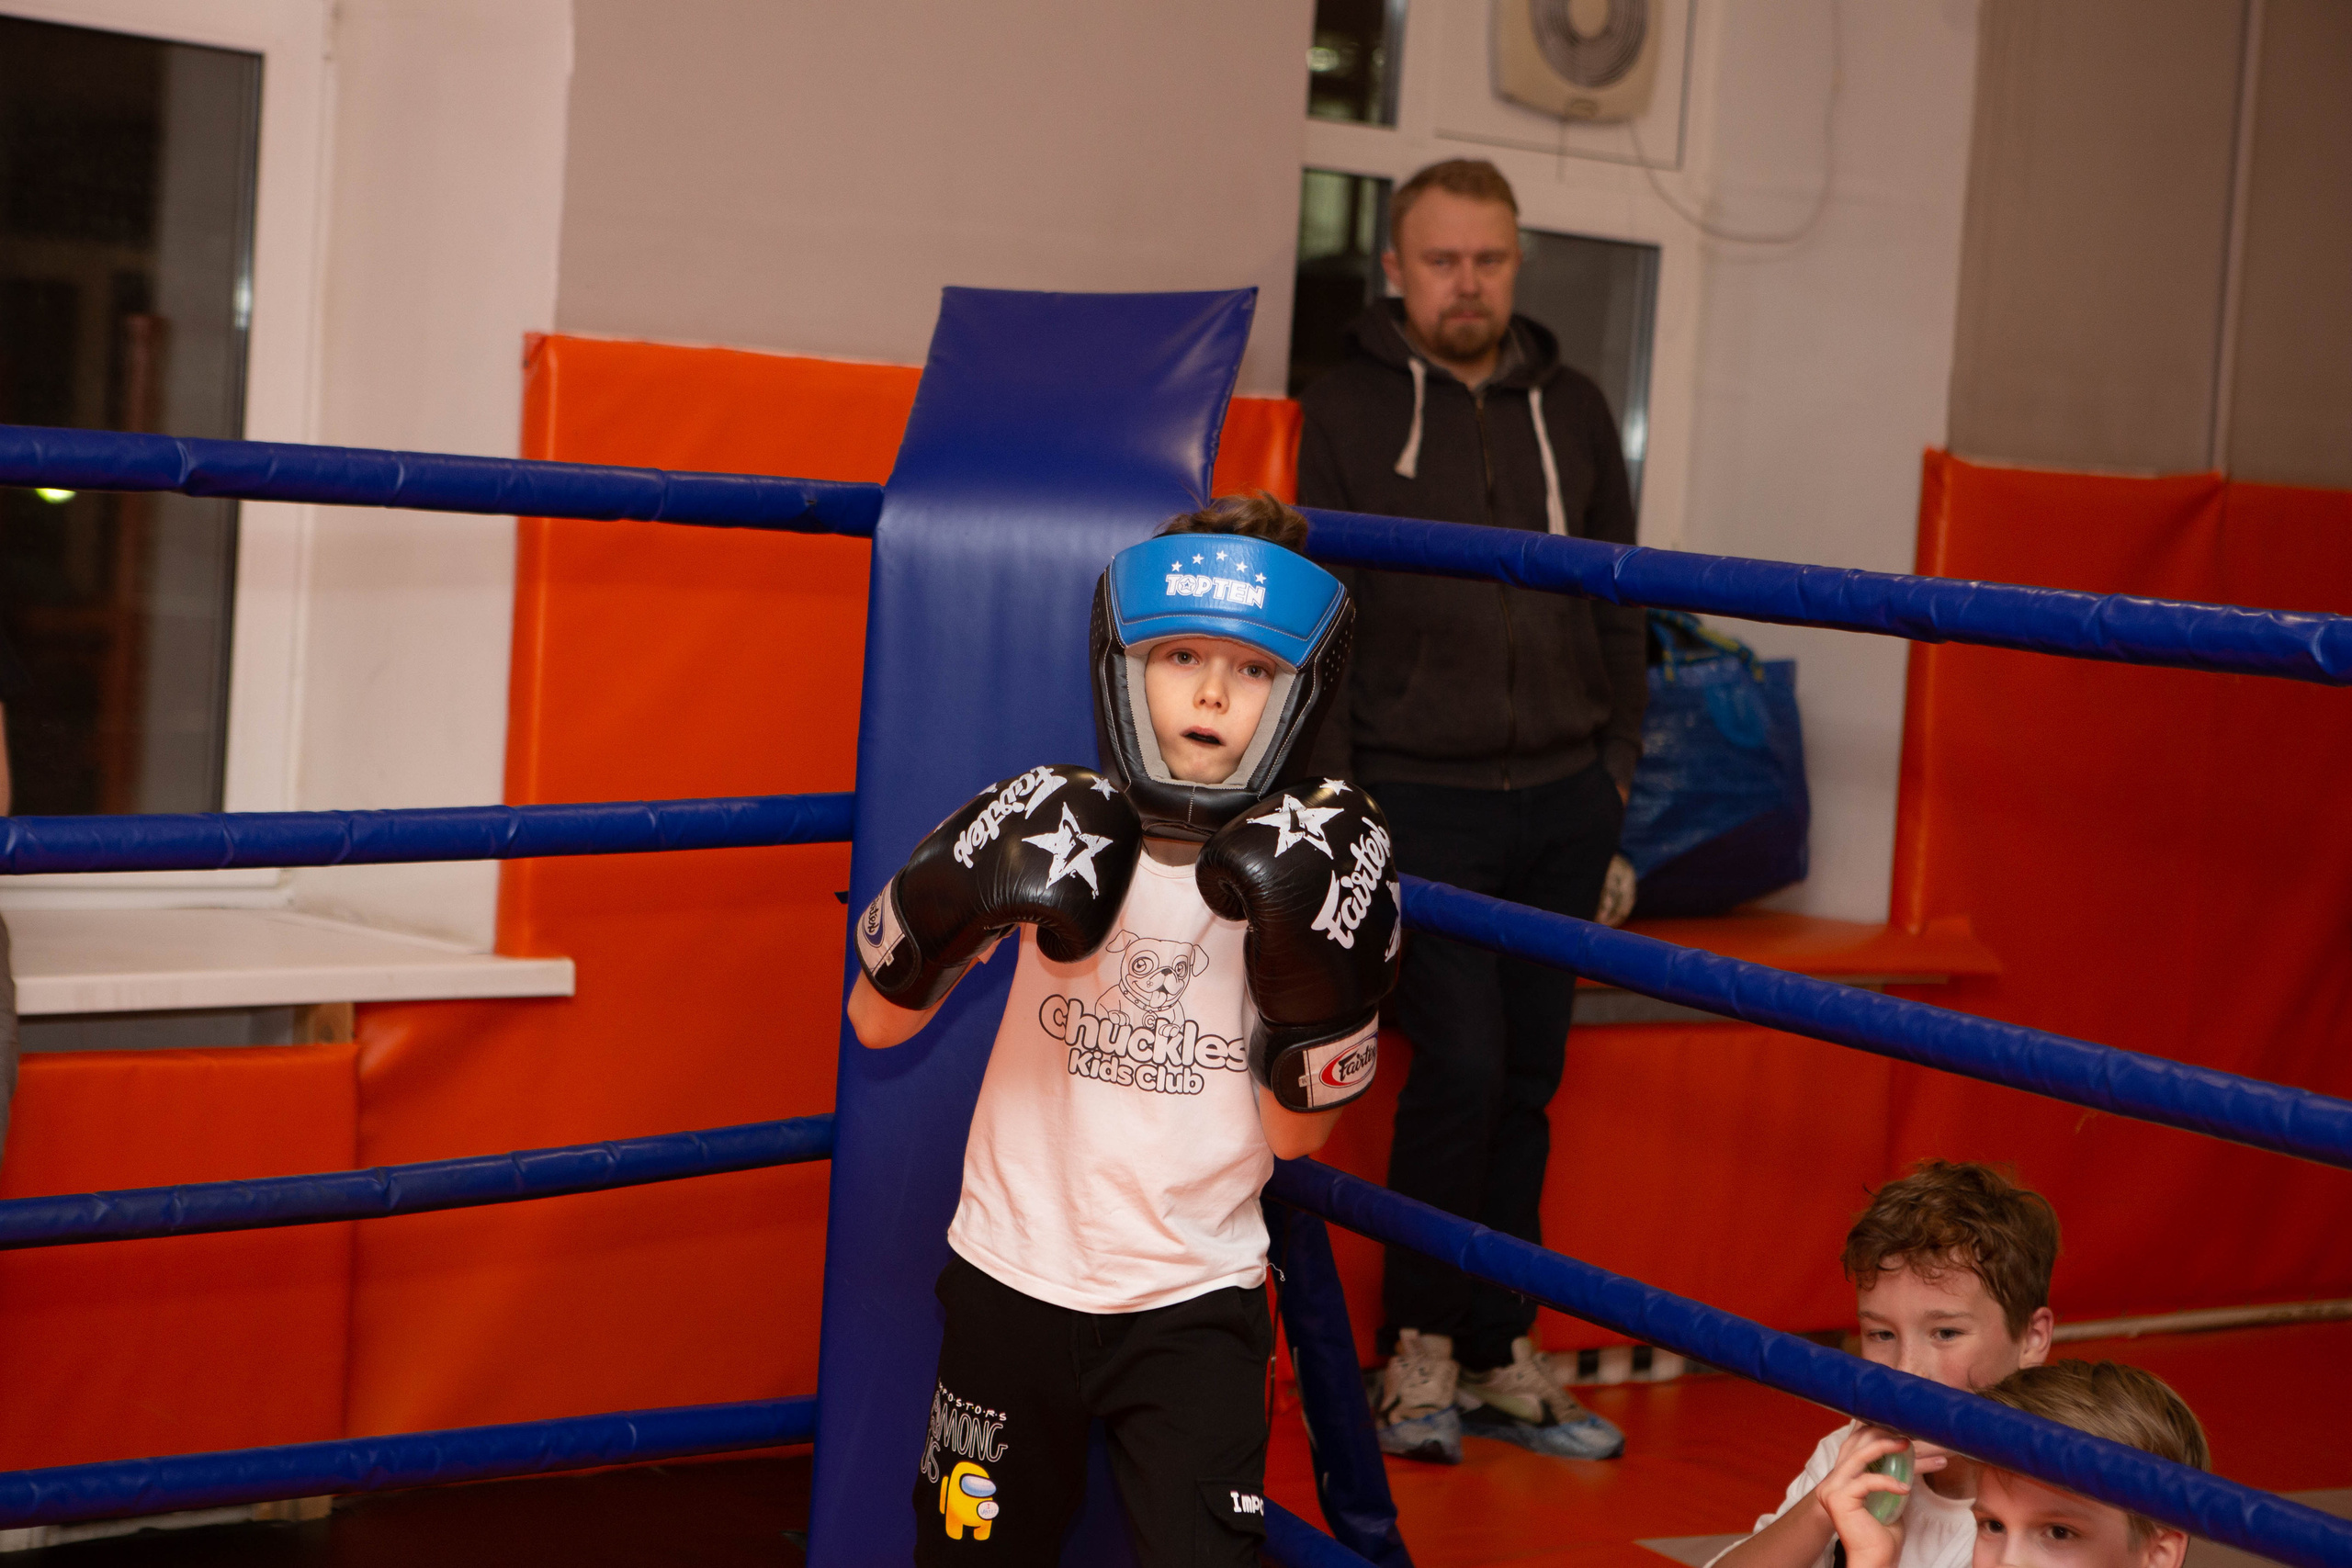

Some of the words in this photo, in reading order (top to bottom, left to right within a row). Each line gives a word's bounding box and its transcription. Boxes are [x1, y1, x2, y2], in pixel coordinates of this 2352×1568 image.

[954, 766, 1068, 869] Fairtex
[1311, 817, 1391, 949] Fairtex
[1039, 994, 1249, 1073] Chuckles
[1068, 1047, 1134, 1087] Kids
[1135, 1064, 1204, 1095] Club
